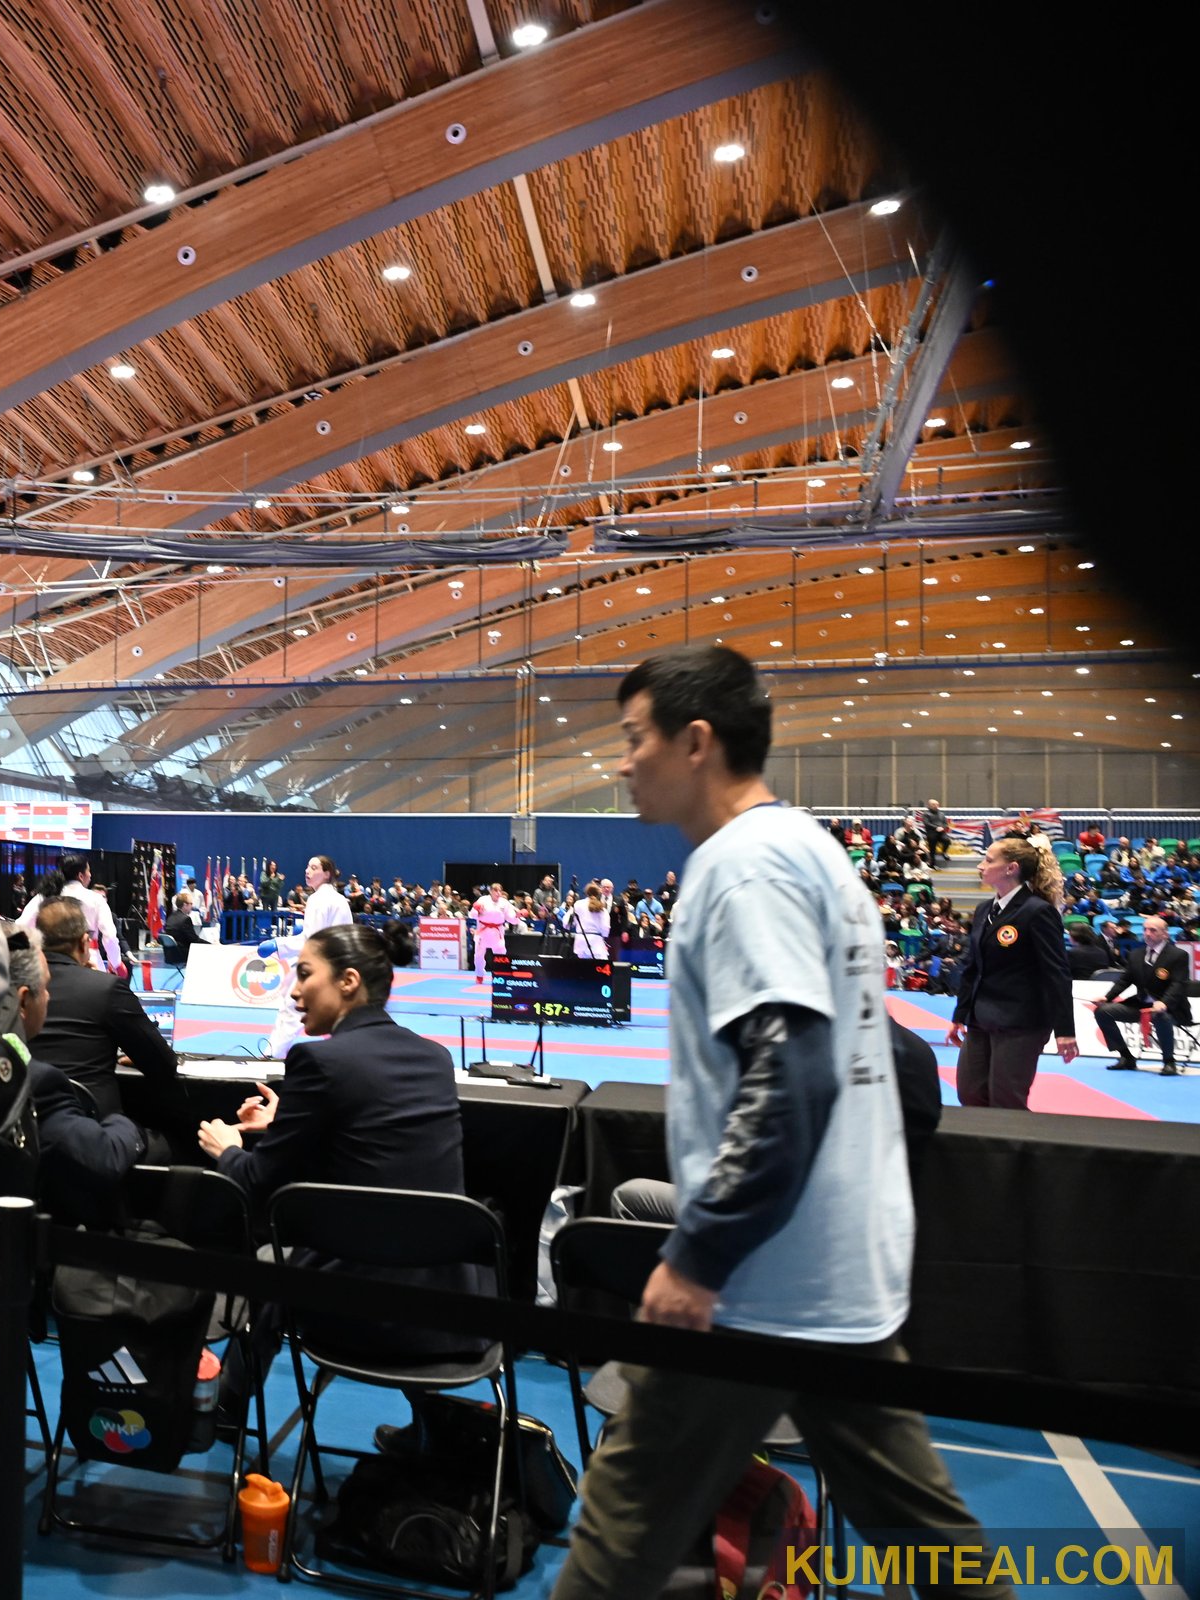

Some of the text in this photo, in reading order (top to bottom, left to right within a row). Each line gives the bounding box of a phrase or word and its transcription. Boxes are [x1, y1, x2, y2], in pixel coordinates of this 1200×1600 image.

[493, 956, 510, 964] AKA
[493, 977, 505, 985] AO
[601, 984, 611, 998] 0
[100, 1419, 140, 1436] WKF
